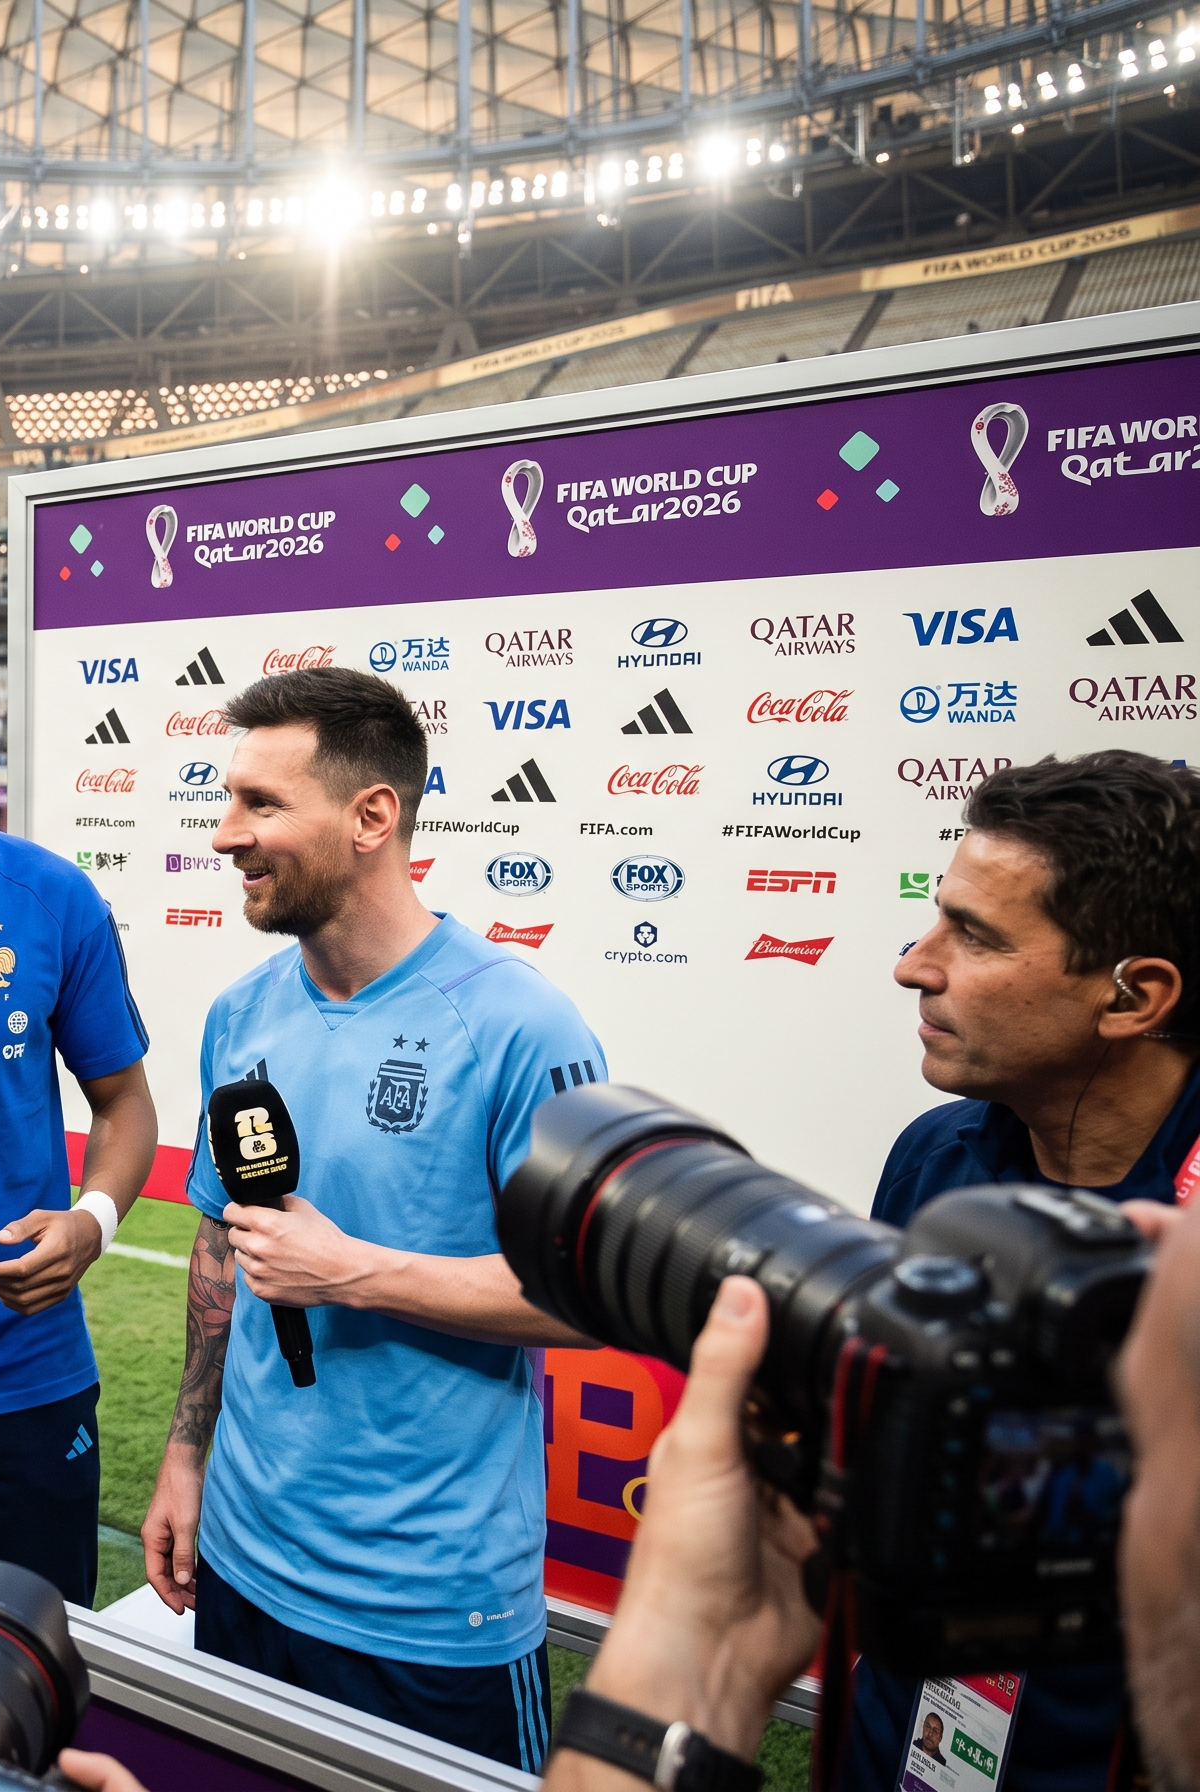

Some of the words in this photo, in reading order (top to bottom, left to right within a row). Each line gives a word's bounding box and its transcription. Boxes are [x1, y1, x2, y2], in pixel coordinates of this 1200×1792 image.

[922, 258, 961, 276] FIFA
[964, 245, 1032, 270] WORLD
[1036, 235, 1077, 254] CUP
[1078, 223, 1131, 245] 2026
[735, 282, 794, 311] FIFA
[1048, 425, 1116, 452] FIFA
[1120, 415, 1200, 444] WOR
[557, 480, 608, 503] FIFA
[611, 469, 701, 496] WORLD
[706, 463, 757, 486] CUP
[187, 523, 225, 542] FIFA
[227, 516, 294, 538] WORLD
[298, 511, 336, 530] CUP
[750, 613, 855, 644] QATAR
[902, 607, 1019, 646] VISA
[402, 637, 449, 658] 万达
[485, 628, 573, 657] QATAR
[775, 638, 856, 657] AIRWAYS
[402, 660, 449, 672] WANDA
[506, 652, 573, 667] AIRWAYS
[617, 652, 701, 668] HYUNDAI
[77, 658, 139, 684] VISA
[948, 681, 1017, 707] 万达
[1069, 674, 1197, 708] QATAR
[483, 699, 571, 730] VISA
[948, 709, 1016, 723] WANDA
[1098, 704, 1198, 721] AIRWAYS
[752, 792, 842, 805] HYUNDAI
[580, 823, 653, 836] FIFA.com
[722, 824, 861, 843] #FIFAWorldCup
[500, 861, 538, 880] FOX
[626, 864, 668, 884] FOX
[499, 879, 538, 887] SPORTS
[626, 883, 669, 892] SPORTS
[746, 869, 836, 893] ESPN
[166, 908, 222, 927] ESPN
[605, 950, 688, 964] crypto.com
